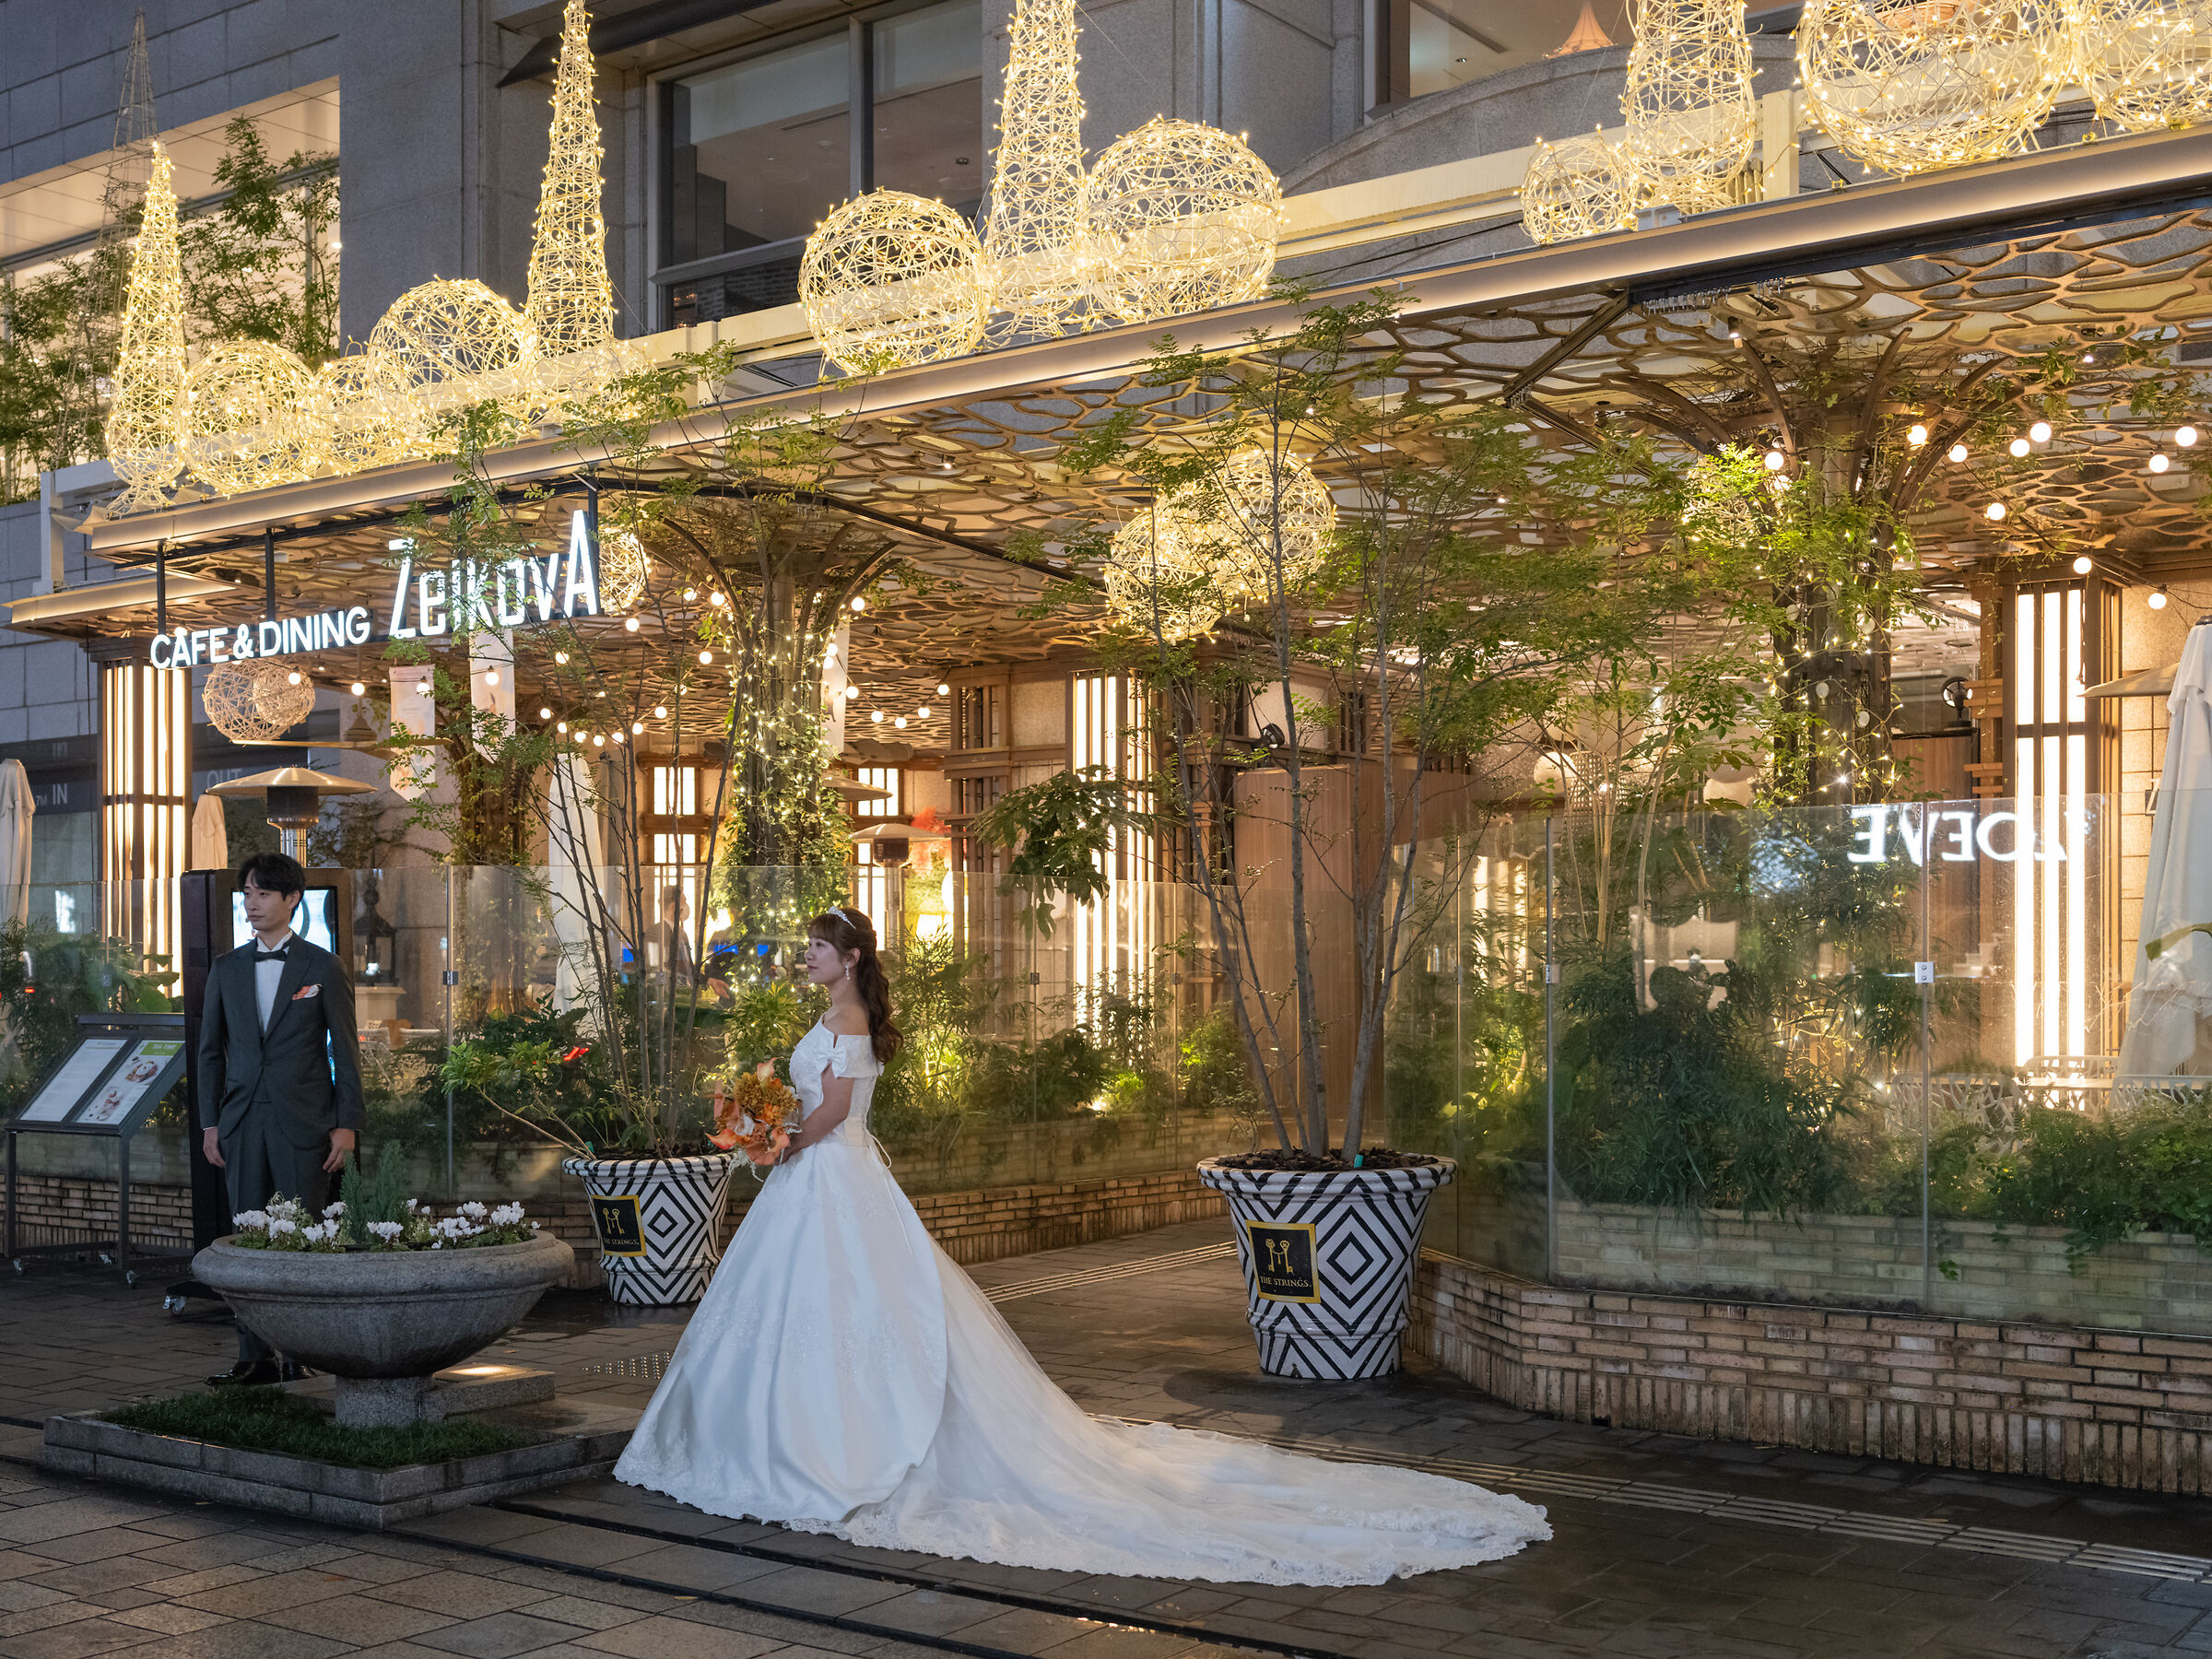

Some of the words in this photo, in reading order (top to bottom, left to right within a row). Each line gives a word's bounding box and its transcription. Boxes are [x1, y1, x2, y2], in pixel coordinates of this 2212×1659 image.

[150, 627, 229, 669] CAFE
[232, 623, 254, 660] &
[259, 606, 371, 657] DINING
[53, 782, 67, 805] IN
[1260, 1276, 1273, 1285] THE
